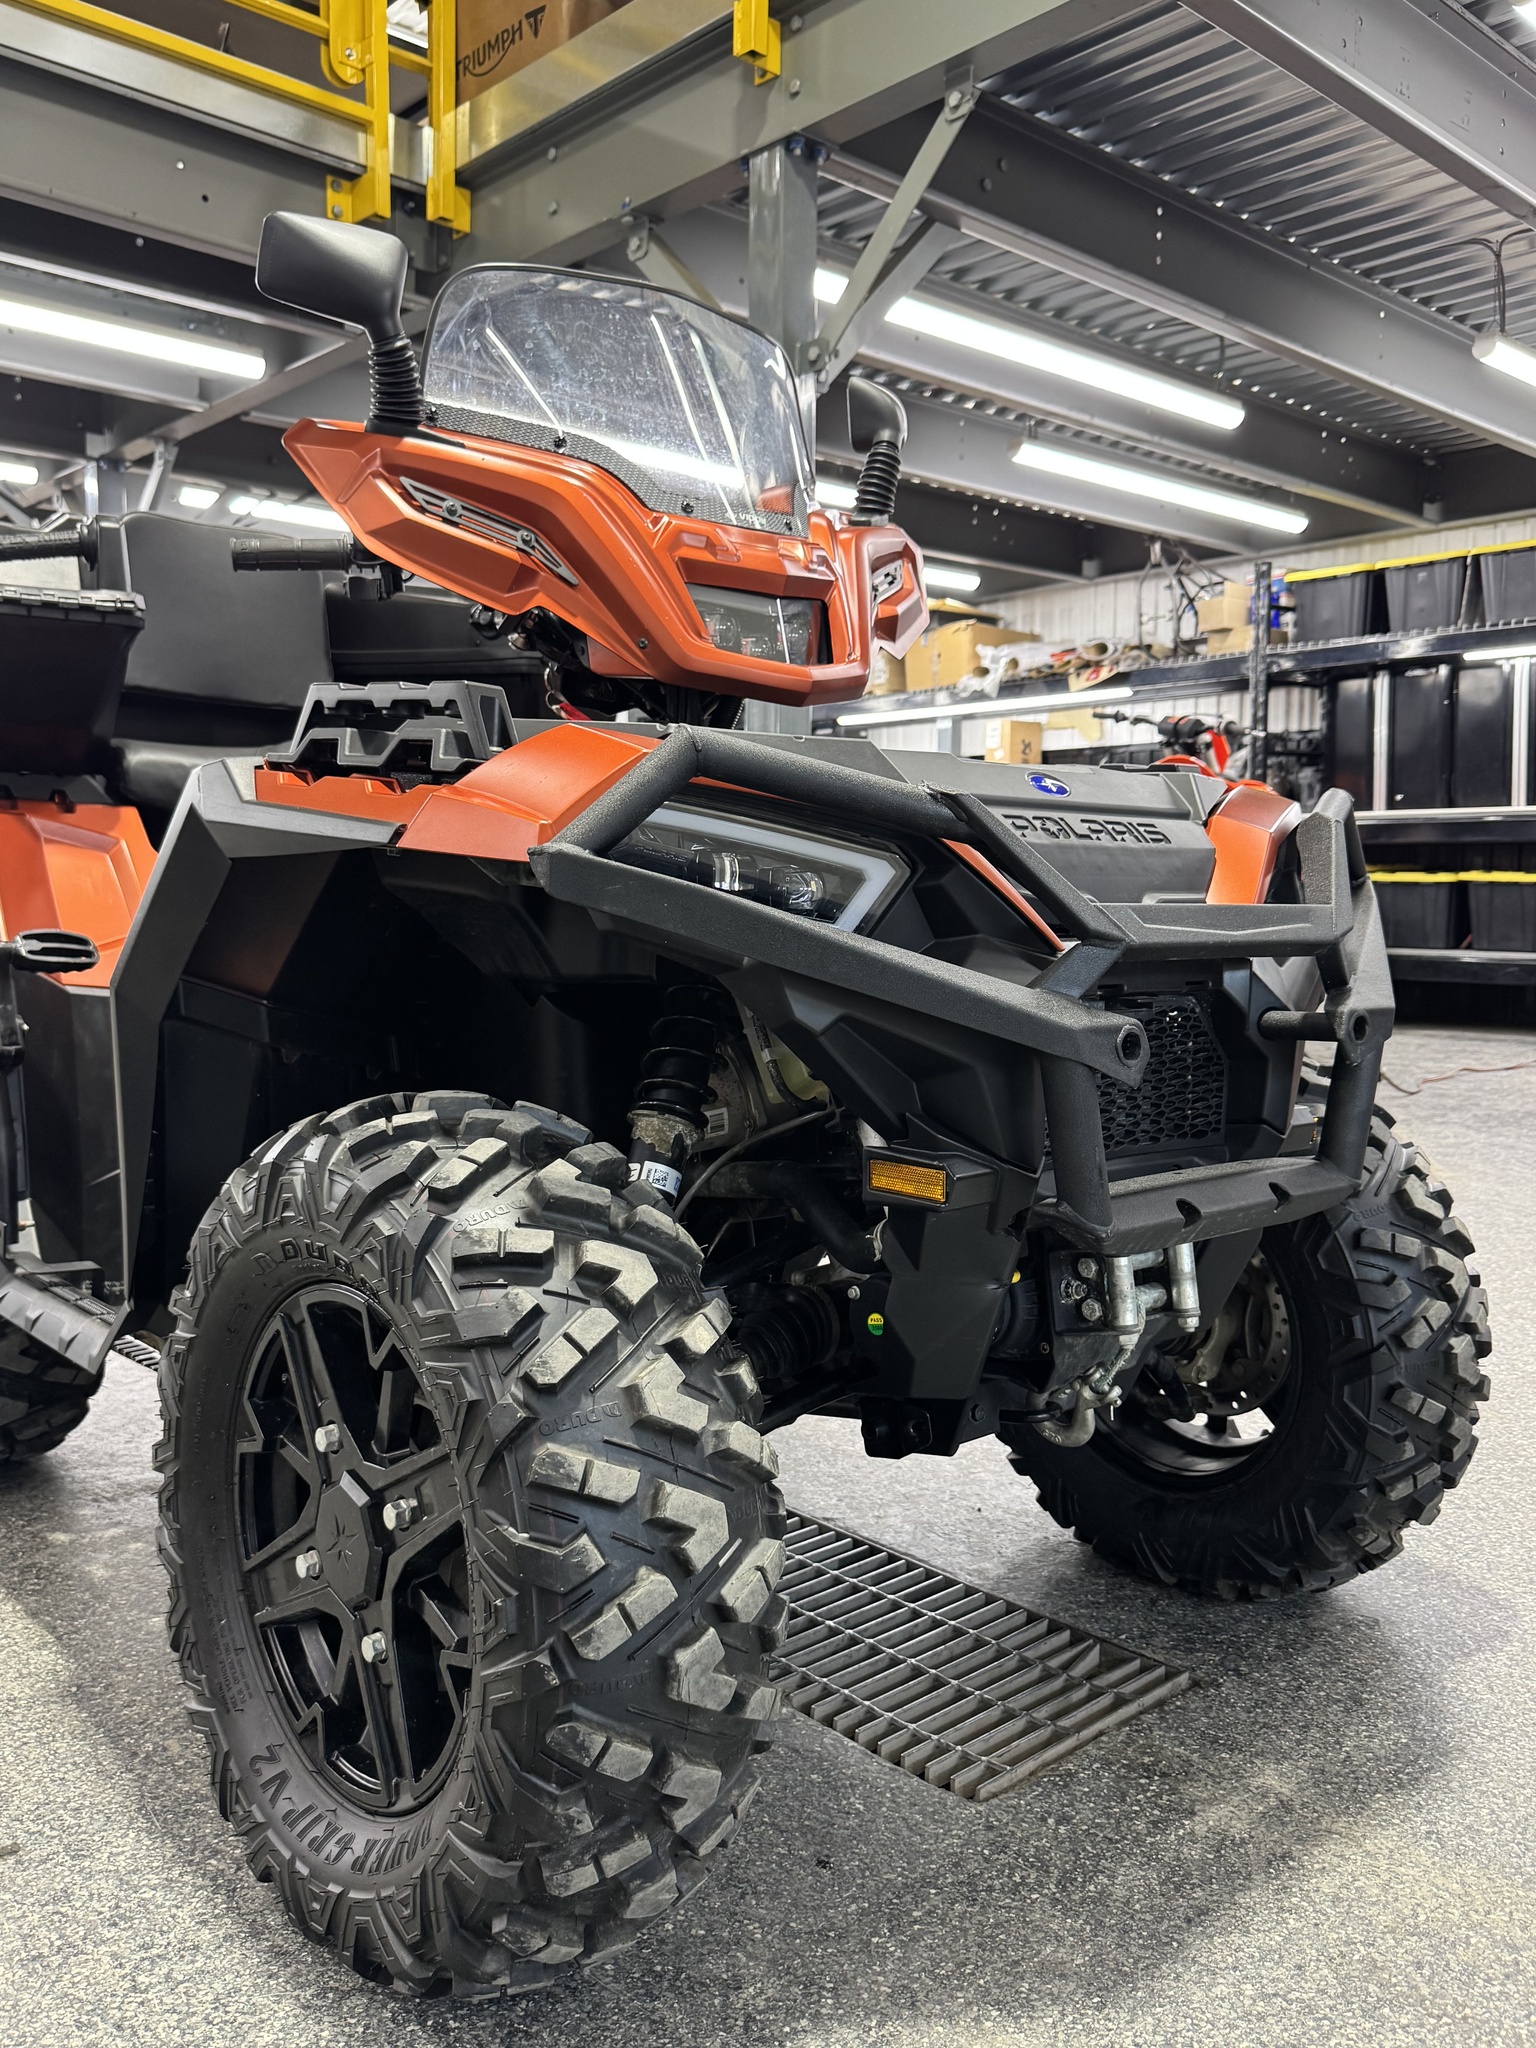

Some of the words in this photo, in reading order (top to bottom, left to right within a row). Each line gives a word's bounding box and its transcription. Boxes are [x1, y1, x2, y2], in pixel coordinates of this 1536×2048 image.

[456, 19, 523, 81] TRIUMPH
[1002, 813, 1172, 845] POLARIS
[453, 1203, 511, 1232] DURO
[538, 1406, 602, 1436] DURO
[249, 1743, 293, 1809] V2
[280, 1802, 357, 1866] GRIP
[351, 1816, 434, 1877] POWER
